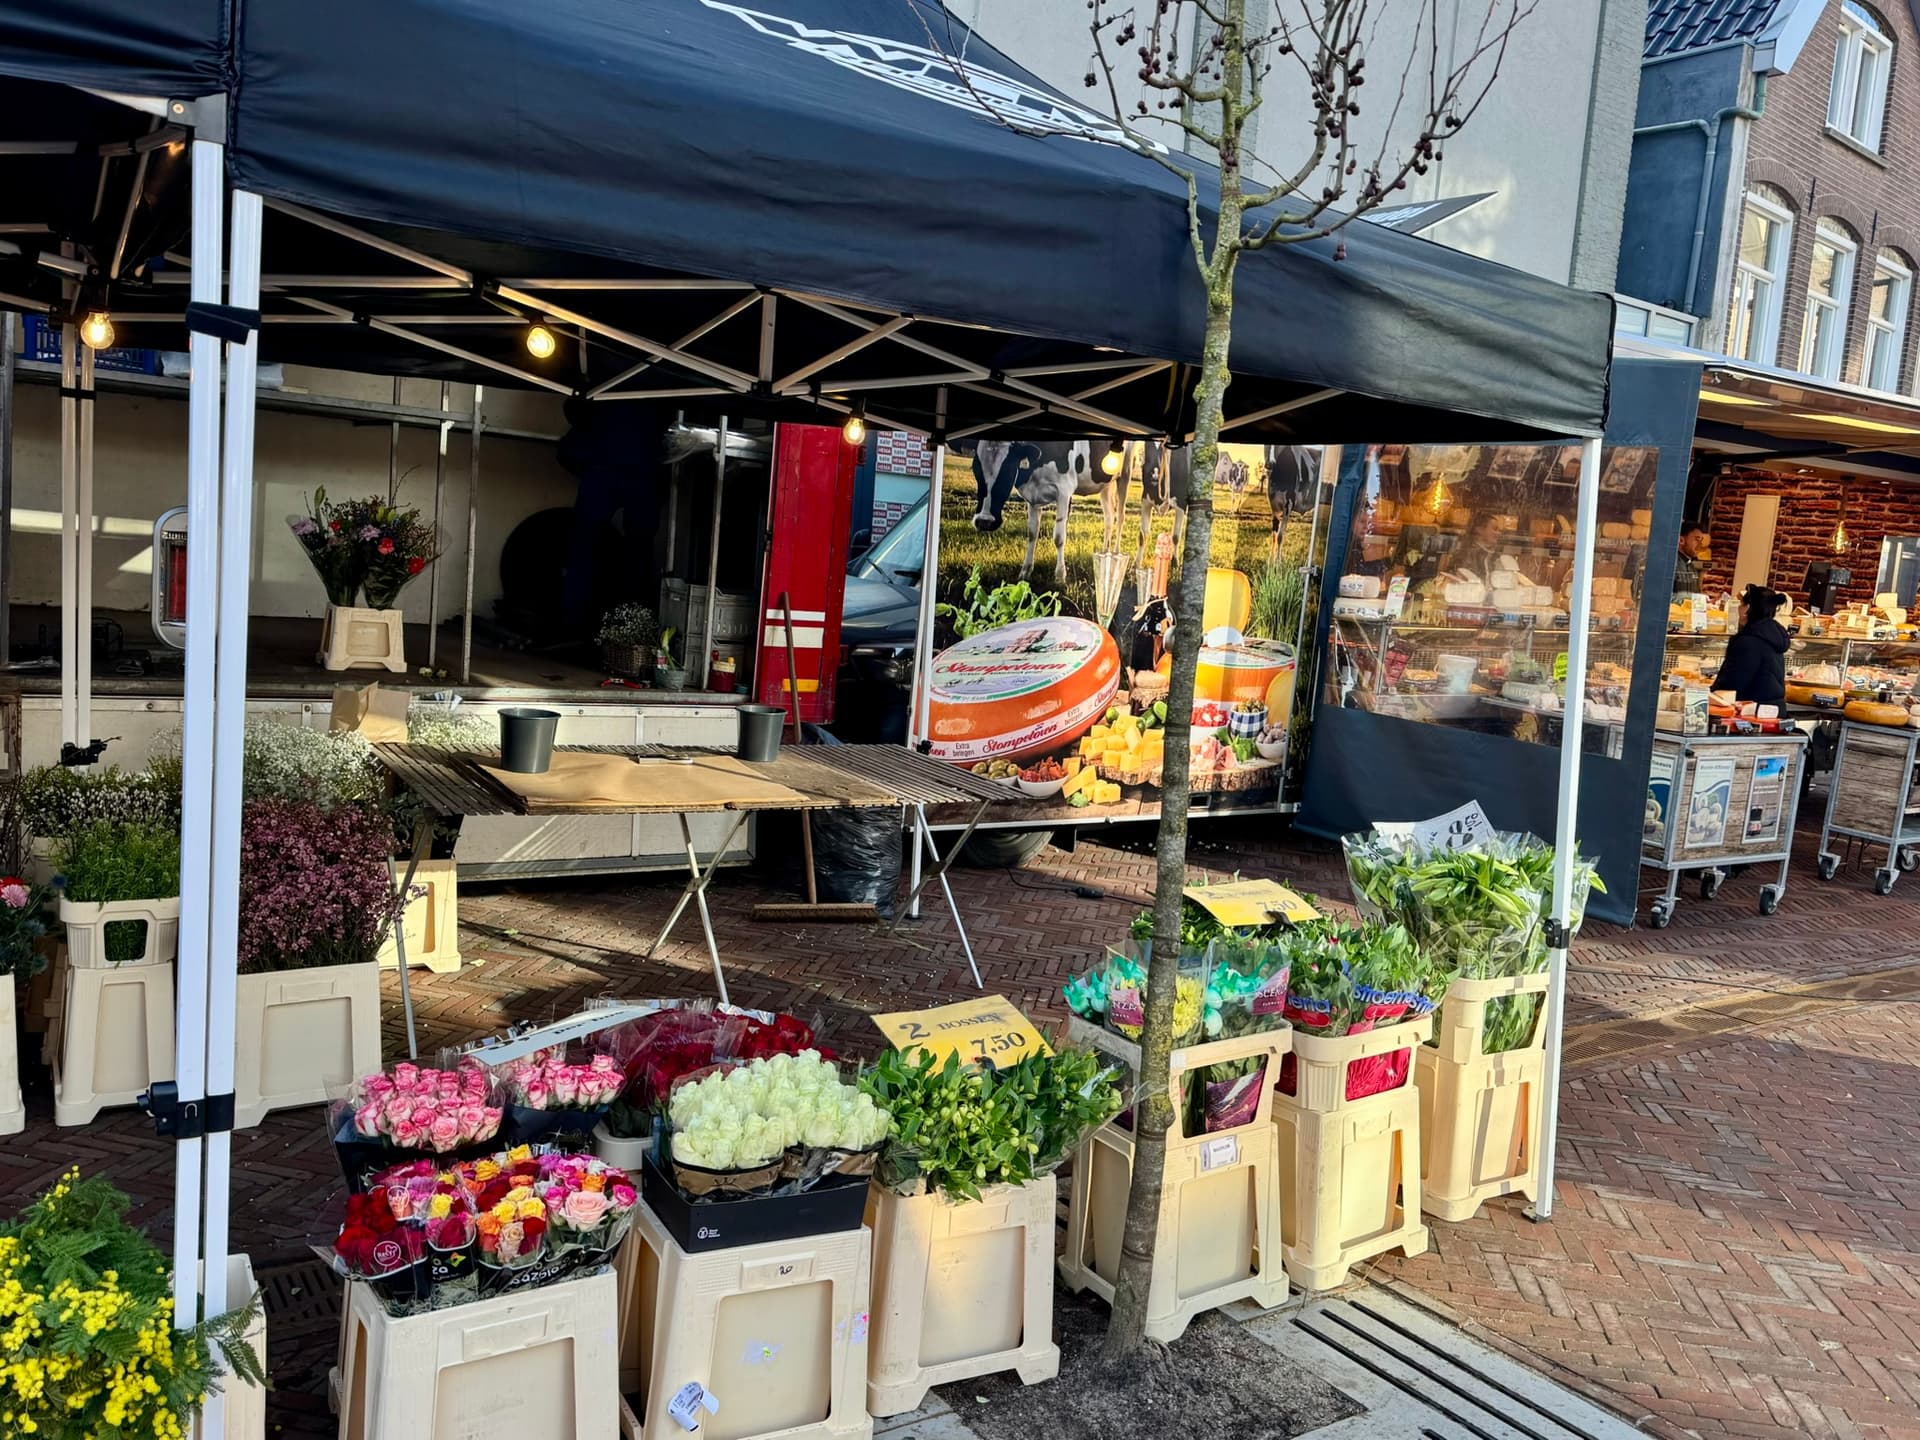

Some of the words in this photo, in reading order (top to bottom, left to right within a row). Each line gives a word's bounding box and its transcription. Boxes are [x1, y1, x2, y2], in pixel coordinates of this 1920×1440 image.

[955, 742, 970, 750] Extra
[898, 1022, 931, 1041] 2
[936, 1011, 1001, 1031] BOSSEN
[970, 1032, 1026, 1056] 7,50
